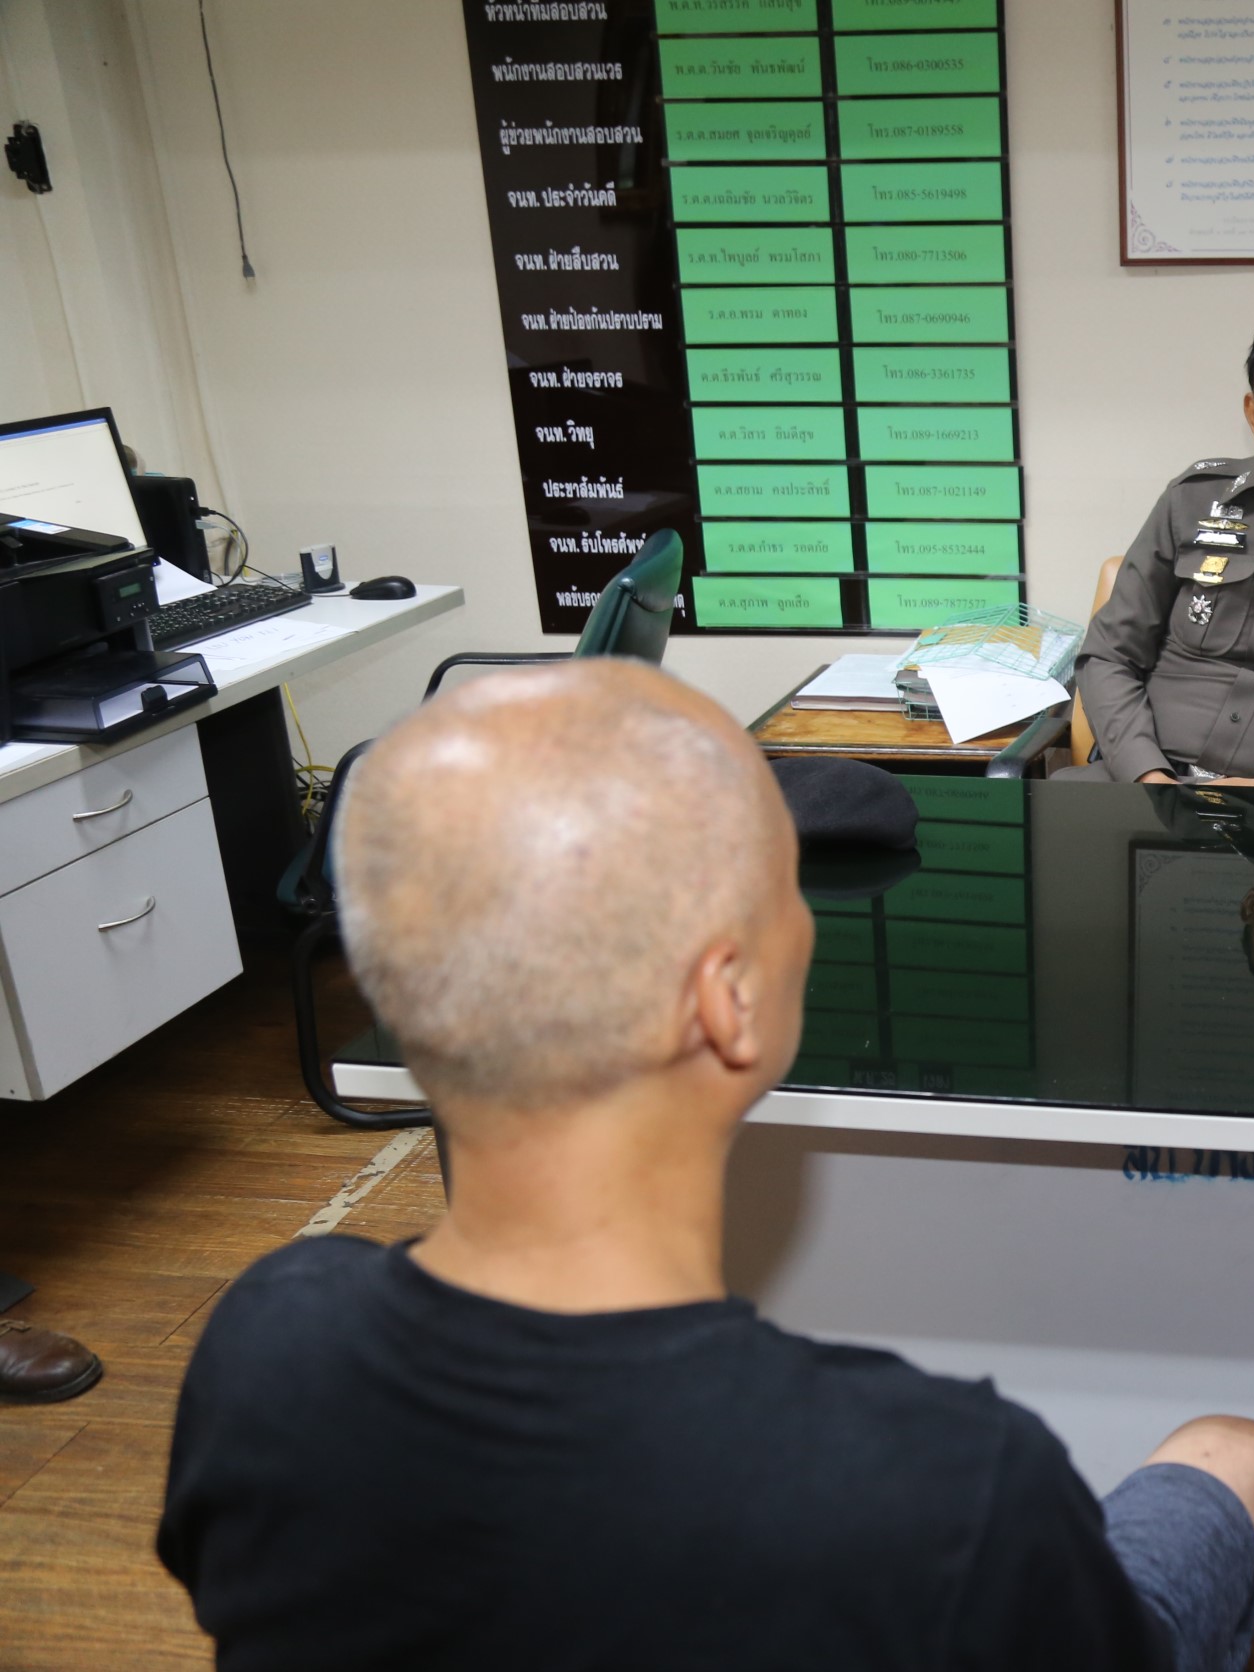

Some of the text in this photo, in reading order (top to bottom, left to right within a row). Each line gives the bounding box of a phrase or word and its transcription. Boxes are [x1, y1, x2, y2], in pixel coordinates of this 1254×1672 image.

[491, 56, 623, 82] พนักงานสอบสวนเวร
[499, 119, 643, 155] ผู้ช่วยพนักงานสอบสวน
[507, 181, 617, 208] จนท. ประจำวันคดี
[515, 245, 620, 271] จนท. ฝ่ายสืบสวน
[521, 306, 663, 330] จนท. ฝ่ายป้องกันปราบปราม
[529, 366, 623, 388] จนท. ฝ่ายจราจร
[535, 419, 595, 450] จนท. วิทยุ
[543, 475, 624, 499] ประชาสัมพันธ์
[549, 537, 580, 553] จนท.
